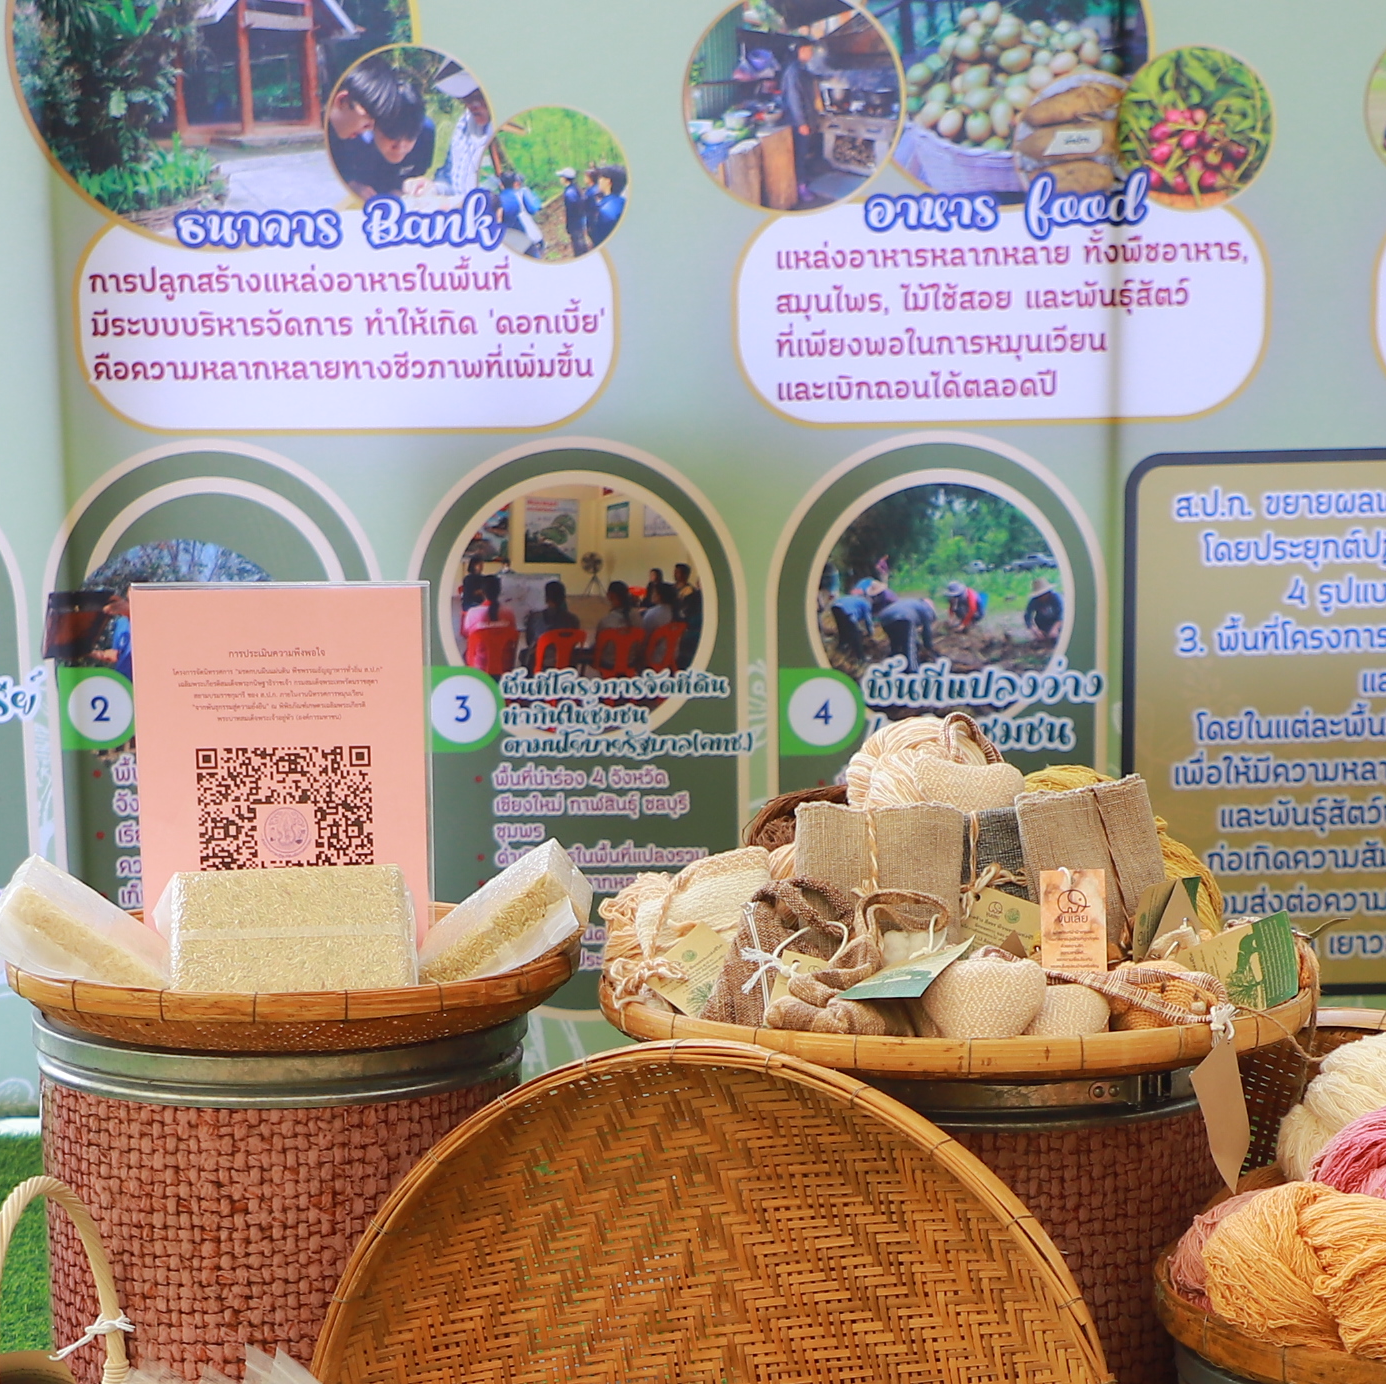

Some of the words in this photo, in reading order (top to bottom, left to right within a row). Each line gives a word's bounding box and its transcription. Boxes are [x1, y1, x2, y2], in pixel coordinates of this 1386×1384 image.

[176, 207, 342, 248] ธนาคาร
[363, 189, 506, 251] Bank
[865, 191, 1001, 233] อาหาร
[1024, 167, 1149, 240] food
[776, 241, 1070, 270] แหล่งอาหารหลากหลาย
[1083, 229, 1249, 266] ทั้งพืชอาหาร,
[88, 256, 513, 302] การปลูกสร้างแหล่งอาหารในพื้นที่
[776, 285, 890, 322] สมุนไพร,
[901, 282, 1012, 311] ไม้ใช้สอย
[1025, 275, 1191, 316] และพันธุ์สัตว์
[90, 306, 353, 339] มีระบบบริหารจัดการ
[365, 304, 478, 337] ทำให้เกิด
[776, 322, 1107, 361] ที่เพียงพอในการหมุนเวียน
[93, 343, 594, 382] คือความหลากหลายทางชีวภาพที่เพิ่มขึ้น
[776, 367, 1058, 402] และเบิกถอนได้ตลอดปี
[1175, 488, 1253, 519] ส.ป.ก.
[1285, 576, 1308, 606] 4
[228, 646, 326, 659] การประเมินความพึงพอใจ
[1178, 625, 1206, 656] 3.
[91, 696, 111, 721] 2
[453, 695, 472, 722] 3
[813, 699, 833, 726] 4
[865, 656, 1106, 702] พื้นที่แปลงว่าง
[493, 763, 585, 789] พื้นที่นำร่อง
[591, 771, 606, 785] 4
[611, 766, 669, 785] จังหวัด
[494, 793, 563, 815] เชียงใหม่
[568, 792, 639, 818] กาฬสินธุ์
[643, 792, 690, 817] ชลบุรี
[494, 824, 545, 842] ชุมพร
